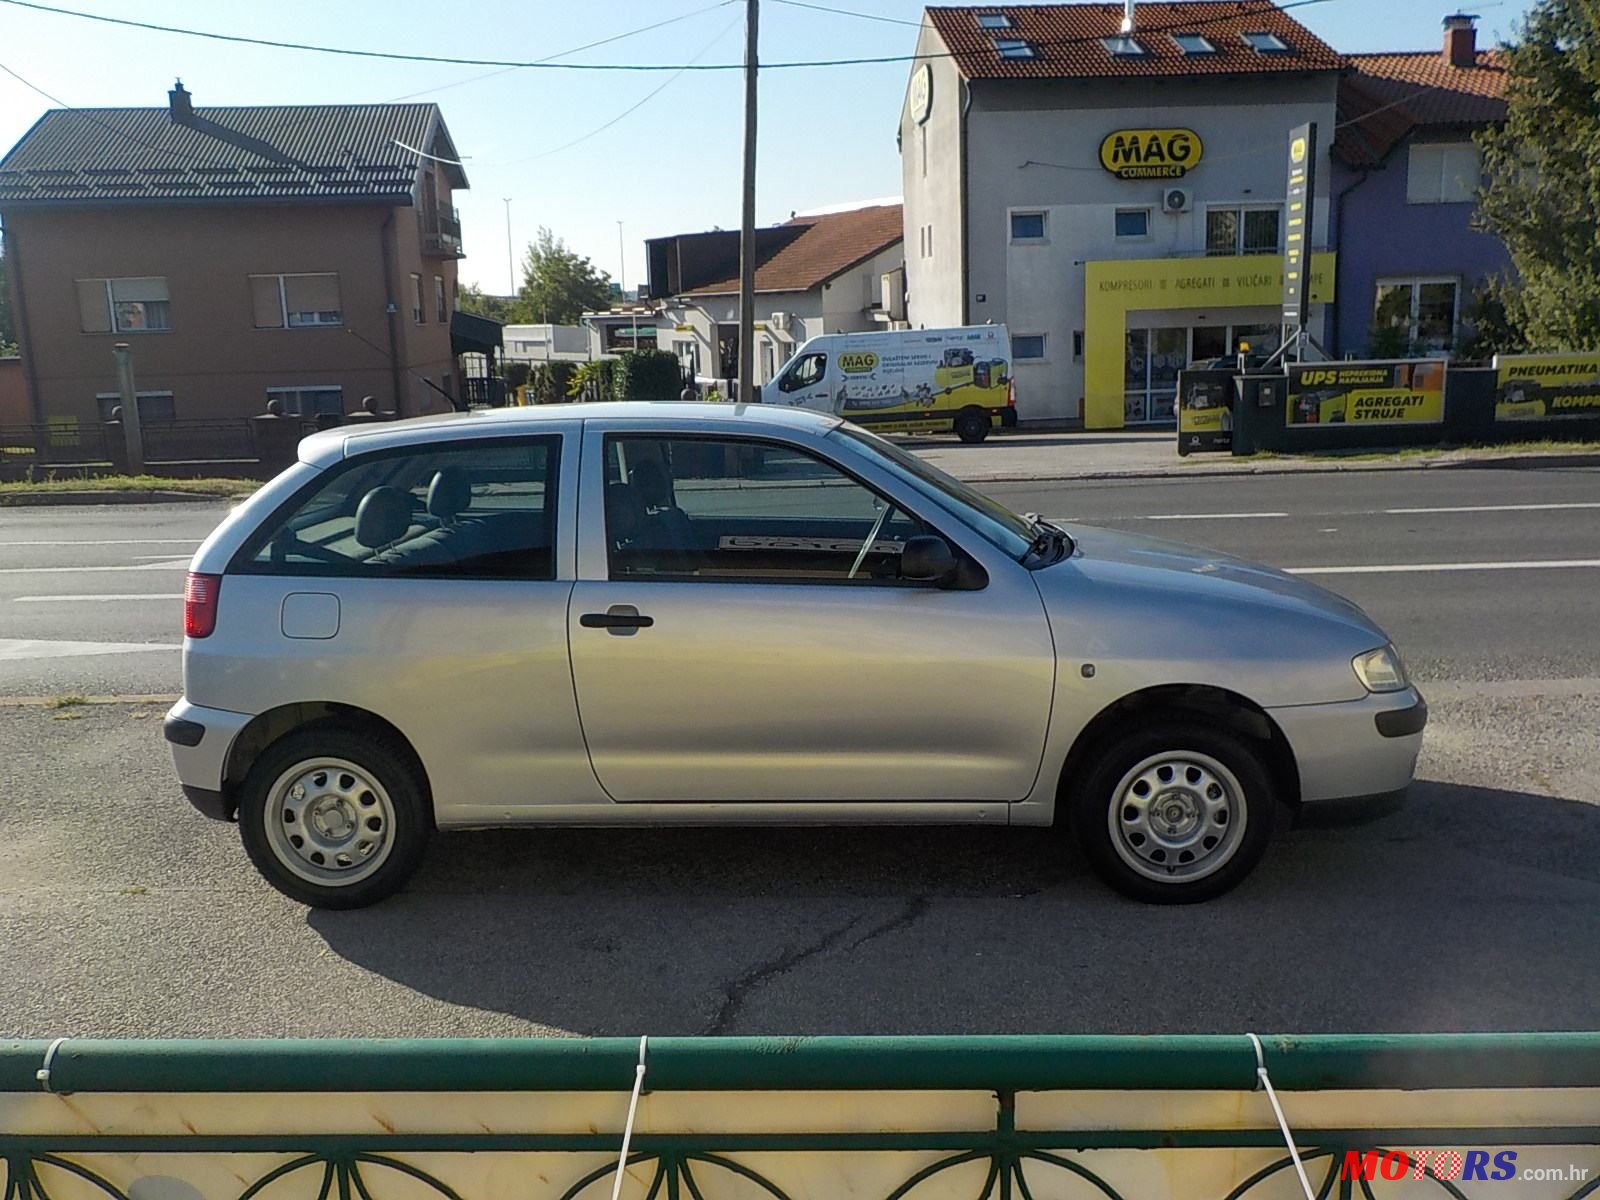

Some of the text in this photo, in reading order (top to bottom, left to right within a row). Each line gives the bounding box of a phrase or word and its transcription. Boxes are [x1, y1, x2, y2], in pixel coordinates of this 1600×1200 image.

[1111, 133, 1192, 163] MAG
[1120, 165, 1183, 178] COMMERCE
[842, 353, 874, 367] MAG
[1508, 363, 1598, 377] PNEUMATIKA
[1301, 370, 1337, 386] UPS
[1355, 395, 1425, 408] AGREGATI
[1354, 408, 1405, 420] STRUJE
